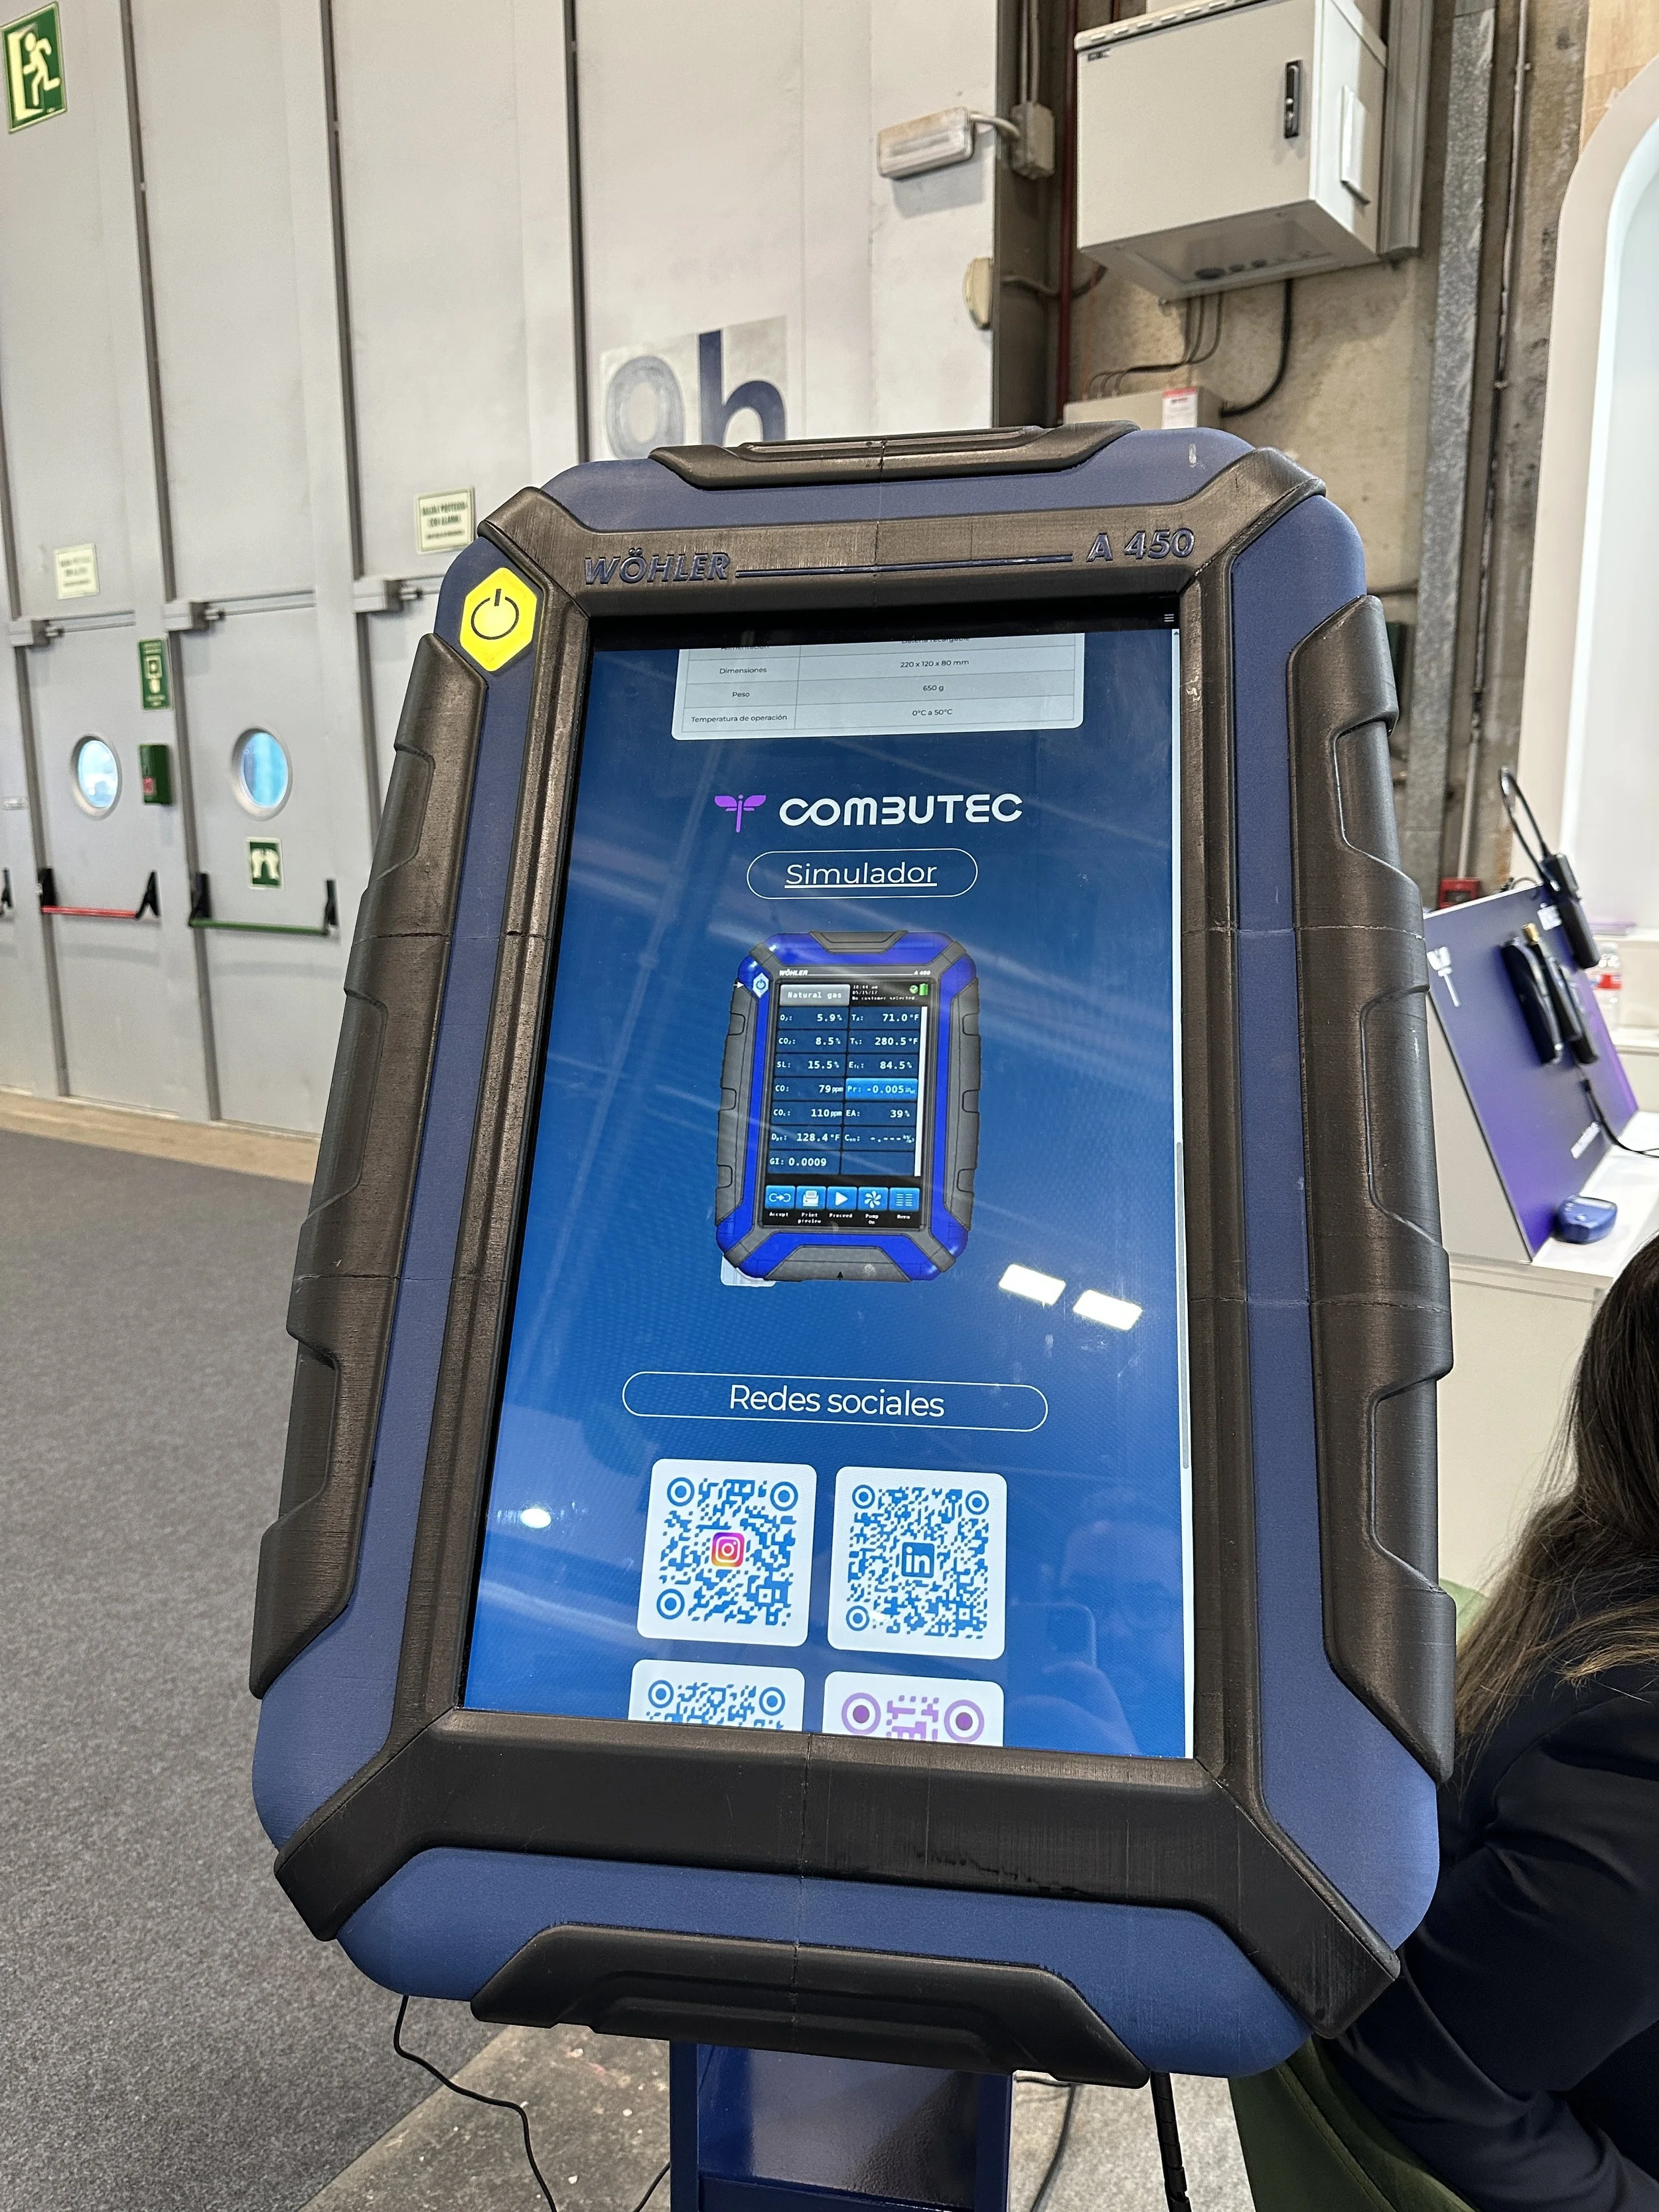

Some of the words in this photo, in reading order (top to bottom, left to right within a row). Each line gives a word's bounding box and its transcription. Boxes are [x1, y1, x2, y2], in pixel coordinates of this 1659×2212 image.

[585, 548, 729, 585] WÖHLER
[1087, 533, 1114, 562] A
[1124, 528, 1194, 559] 450
[751, 713, 787, 723] operación
[778, 793, 1023, 826] COMBUTEC
[785, 861, 938, 886] Simulador
[788, 1157, 827, 1167] 0.0009
[730, 1384, 822, 1412] Redes
[827, 1388, 945, 1418] sociales
